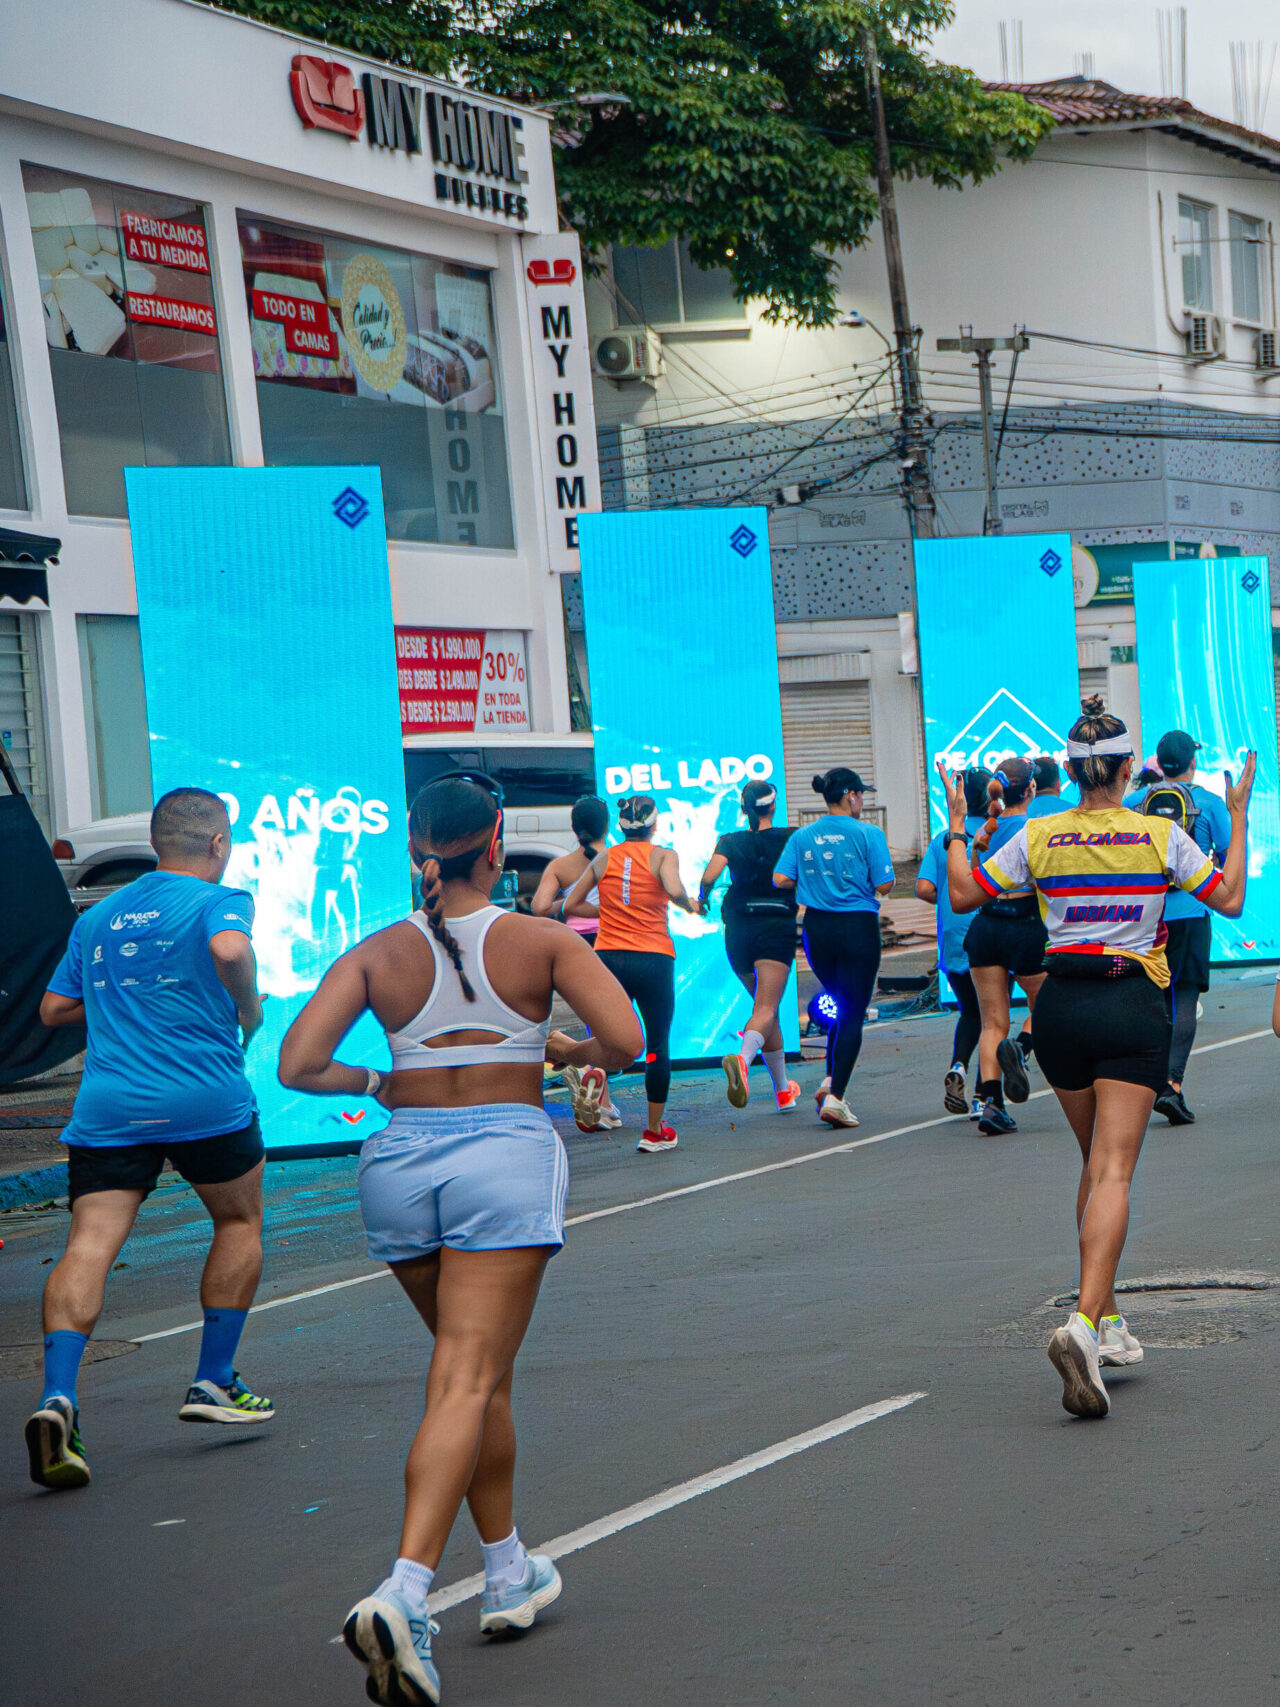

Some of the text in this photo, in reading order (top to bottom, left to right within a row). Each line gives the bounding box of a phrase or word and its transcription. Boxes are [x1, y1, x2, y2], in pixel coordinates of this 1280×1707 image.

[362, 73, 529, 184] MY HOME
[126, 214, 205, 247] FABRICAMOS
[129, 238, 208, 270] A TU MEDIDA
[129, 297, 215, 329] RESTAURAMOS
[262, 296, 316, 323] TODO EN
[293, 329, 331, 352] CAMAS
[540, 305, 572, 378] MY
[397, 636, 428, 658] DESDE
[399, 669, 412, 690] RES
[413, 669, 438, 690] DESDE
[485, 652, 525, 682] 30%
[407, 701, 433, 722] DESDE
[484, 692, 522, 706] EN TODA
[483, 711, 527, 724] LA TIENDA
[605, 753, 774, 795] DEL LADO
[250, 787, 390, 835] AÑOS
[1047, 832, 1151, 849] COLOMBIA
[1063, 904, 1145, 923] ADRIANA
